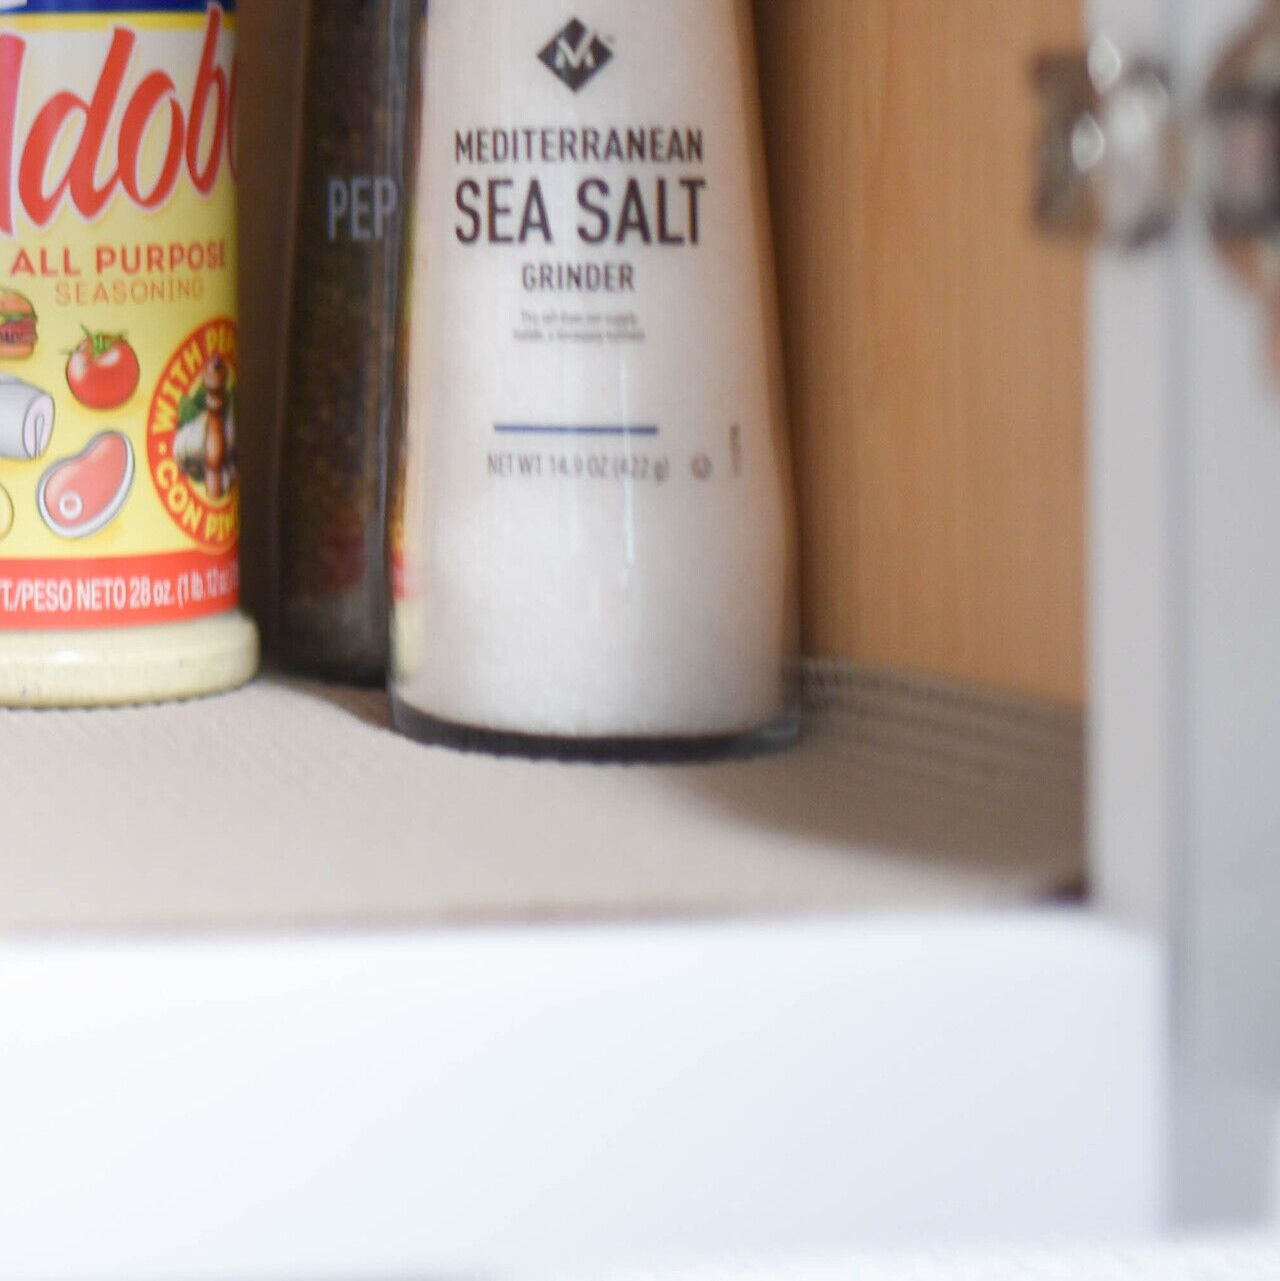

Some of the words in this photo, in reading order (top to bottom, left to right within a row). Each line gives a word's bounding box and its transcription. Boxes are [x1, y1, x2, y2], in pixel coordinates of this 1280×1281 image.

[454, 127, 704, 165] MEDITERRANEAN
[455, 178, 553, 246] SEA
[576, 178, 707, 246] SALT
[9, 248, 82, 278] ALL
[521, 262, 636, 293] GRINDER
[54, 276, 205, 307] SEASONING
[76, 576, 127, 611] NETO
[129, 574, 151, 606] 28
